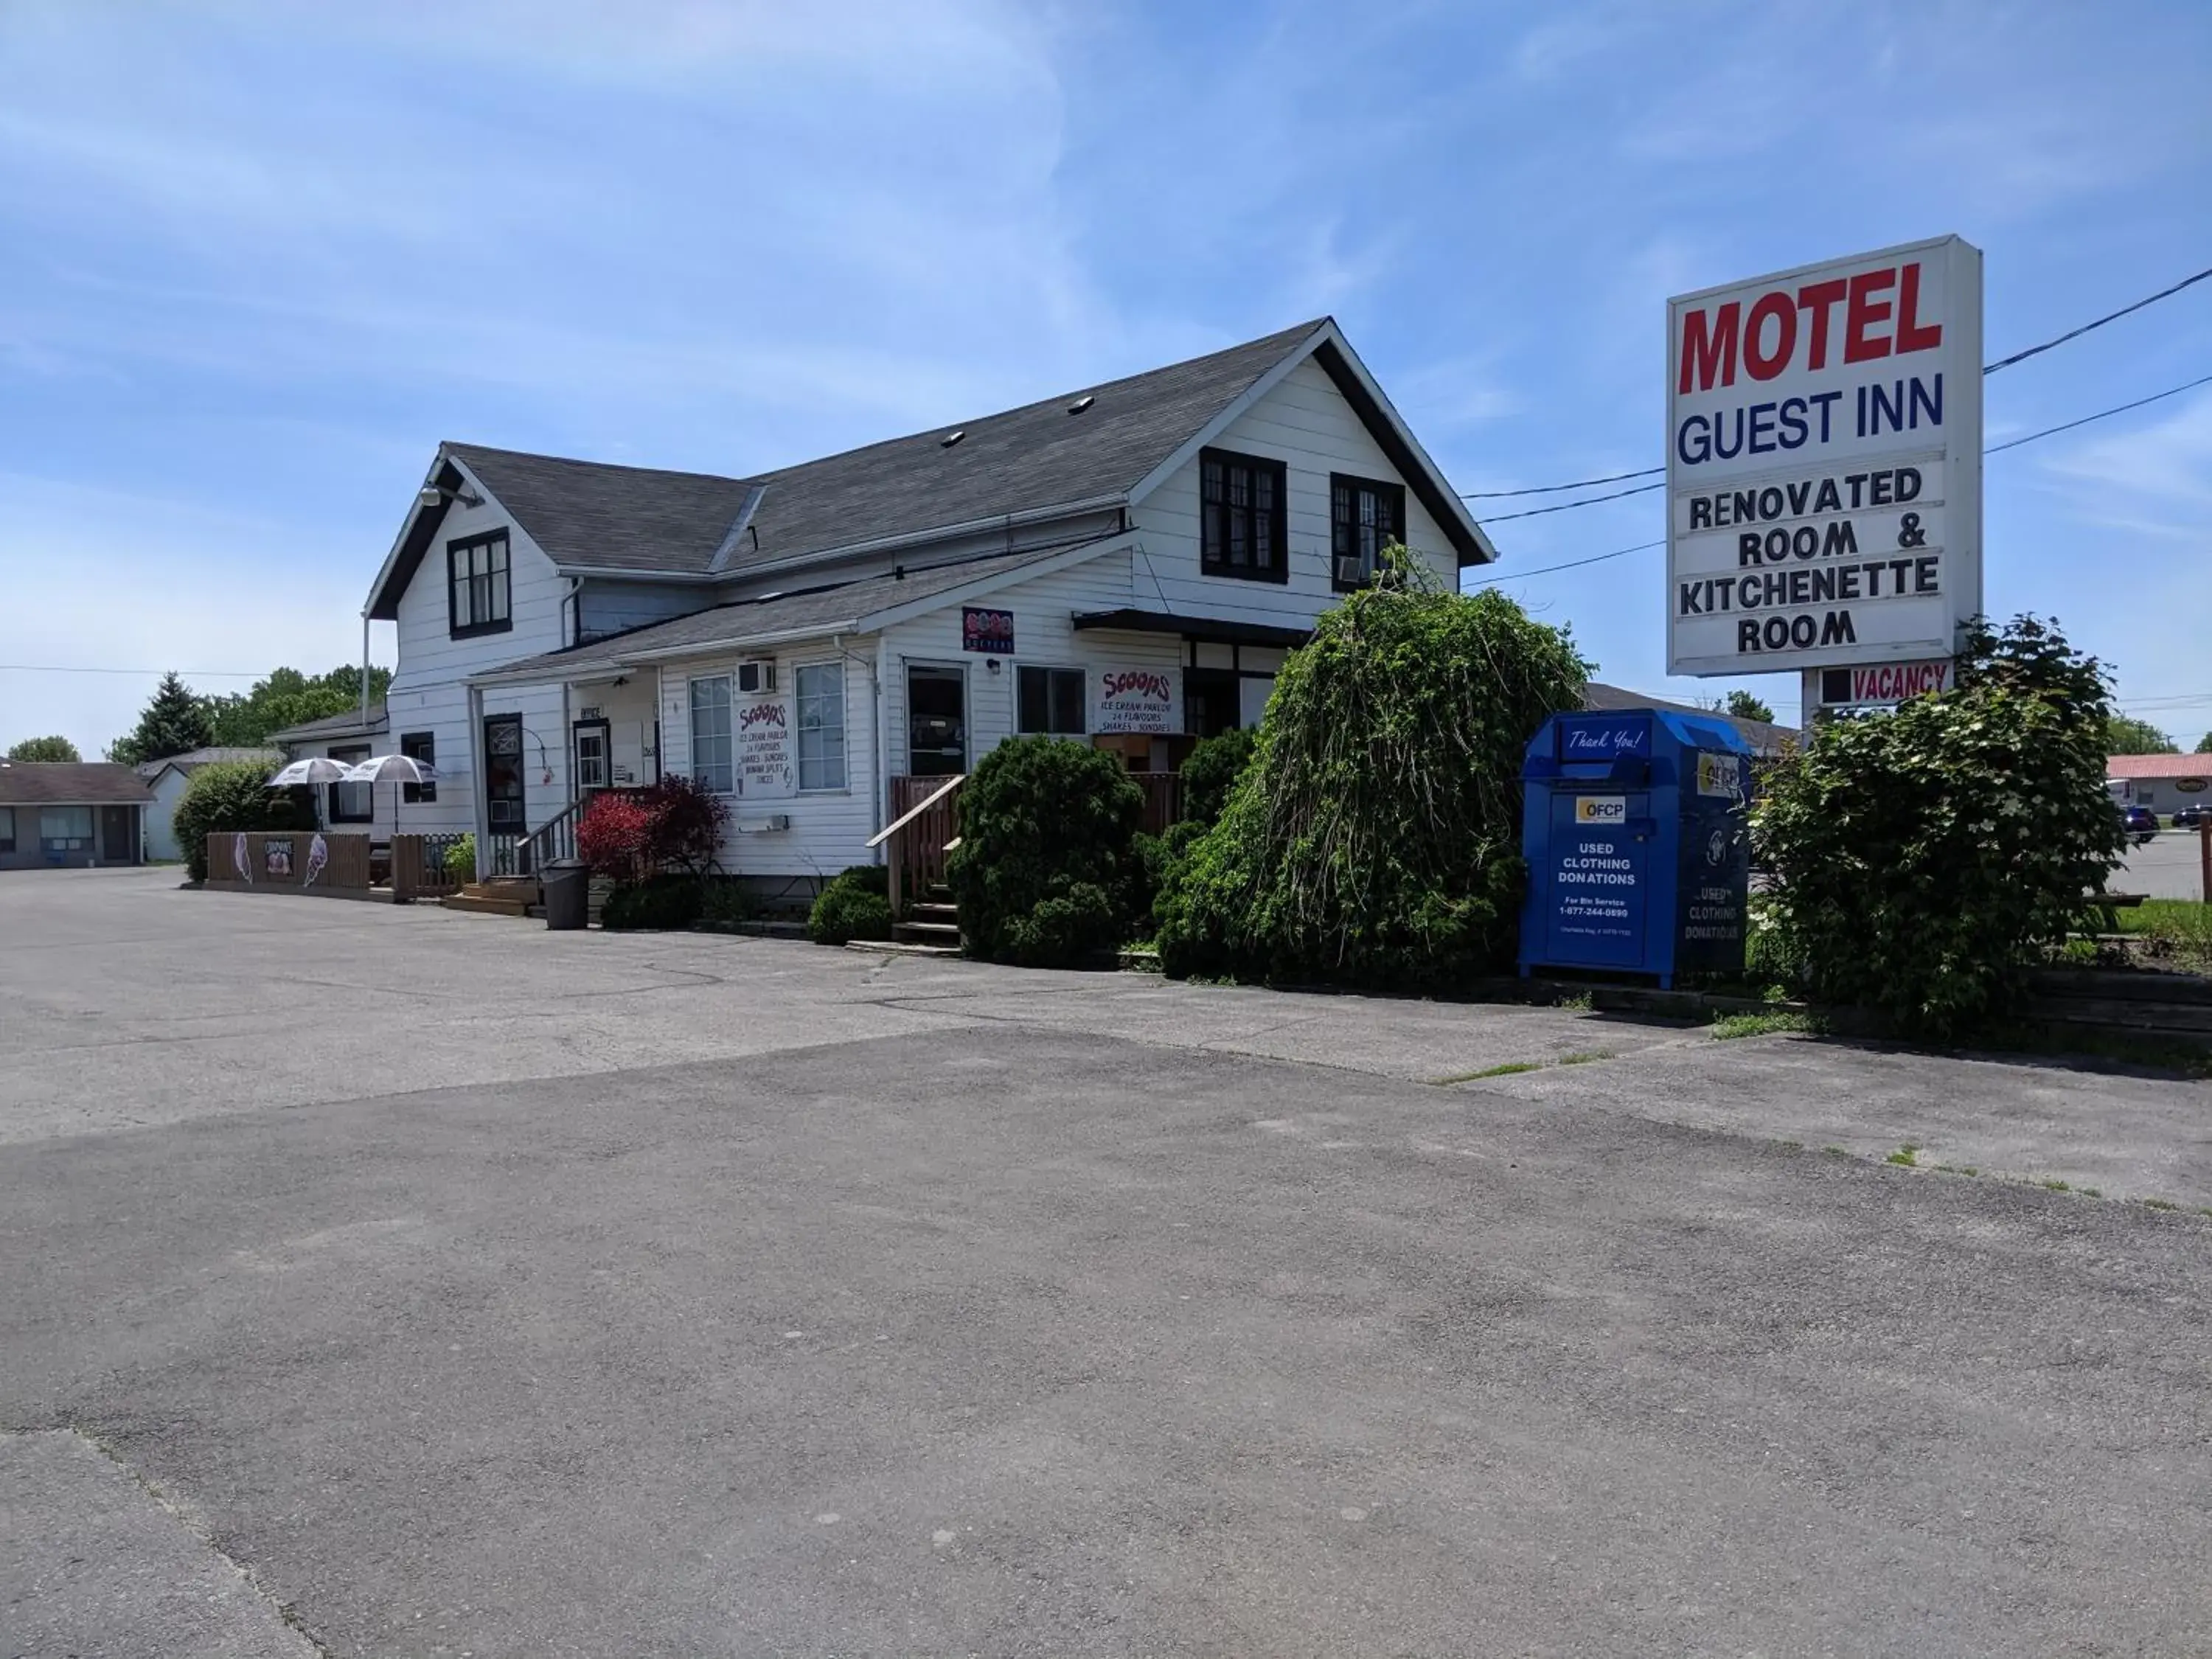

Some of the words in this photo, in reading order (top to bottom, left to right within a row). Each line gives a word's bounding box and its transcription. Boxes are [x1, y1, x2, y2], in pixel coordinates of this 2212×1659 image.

[1679, 262, 1943, 394] MOTEL
[1677, 390, 1842, 465] GUEST
[1857, 373, 1943, 437] INN
[1690, 467, 1922, 529] RENOVATED
[1739, 521, 1858, 566] ROOM
[1898, 512, 1926, 548] &
[1680, 557, 1938, 615] KITCHENETTE
[1738, 610, 1857, 653] ROOM
[1854, 665, 1947, 700] VACANCY
[1101, 701, 1114, 709] ICE
[1116, 701, 1141, 711] CREAM
[1102, 722, 1132, 731] SHAKES
[1569, 731, 1610, 748] Thank
[1614, 731, 1644, 749] You!
[1587, 804, 1624, 816] OFCP
[1579, 843, 1614, 855] USED
[1563, 858, 1631, 869] CLOTHING
[1558, 872, 1635, 886] DONATIONS
[1565, 896, 1579, 904] For
[1595, 897, 1626, 906] Service
[1701, 887, 1726, 900] USED
